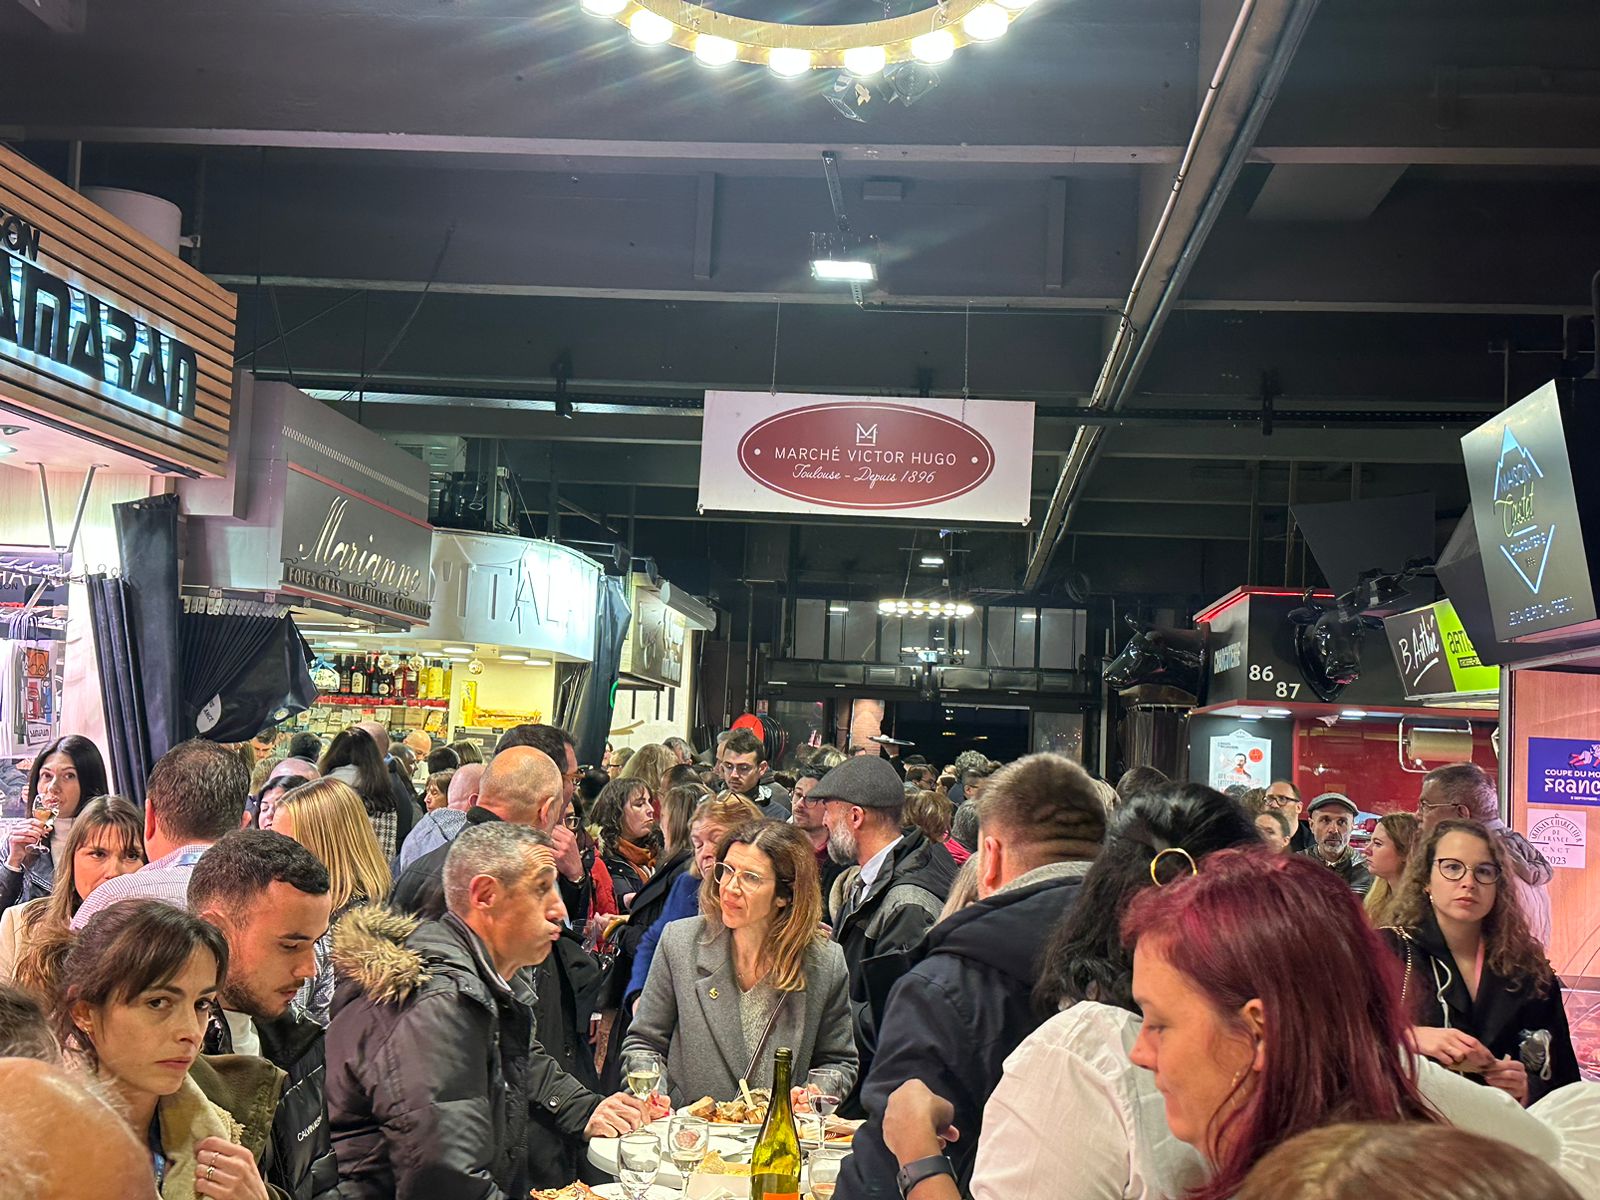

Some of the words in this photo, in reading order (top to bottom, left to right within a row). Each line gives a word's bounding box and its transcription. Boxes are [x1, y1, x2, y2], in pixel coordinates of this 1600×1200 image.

[0, 214, 40, 262] ON
[774, 446, 841, 462] MARCHÉ
[847, 450, 905, 464] VICTOR
[911, 452, 957, 466] HUGO
[792, 463, 842, 480] Toulouse
[853, 466, 897, 489] Depuis
[900, 470, 936, 484] 1896
[299, 496, 421, 592] Marianne
[289, 567, 316, 588] FOIES
[318, 572, 341, 593] GRAS
[1249, 664, 1274, 682] 86
[1275, 682, 1301, 699] 87
[1544, 769, 1573, 777] COUPE
[1574, 770, 1587, 778] DU
[1546, 855, 1567, 865] 2023
